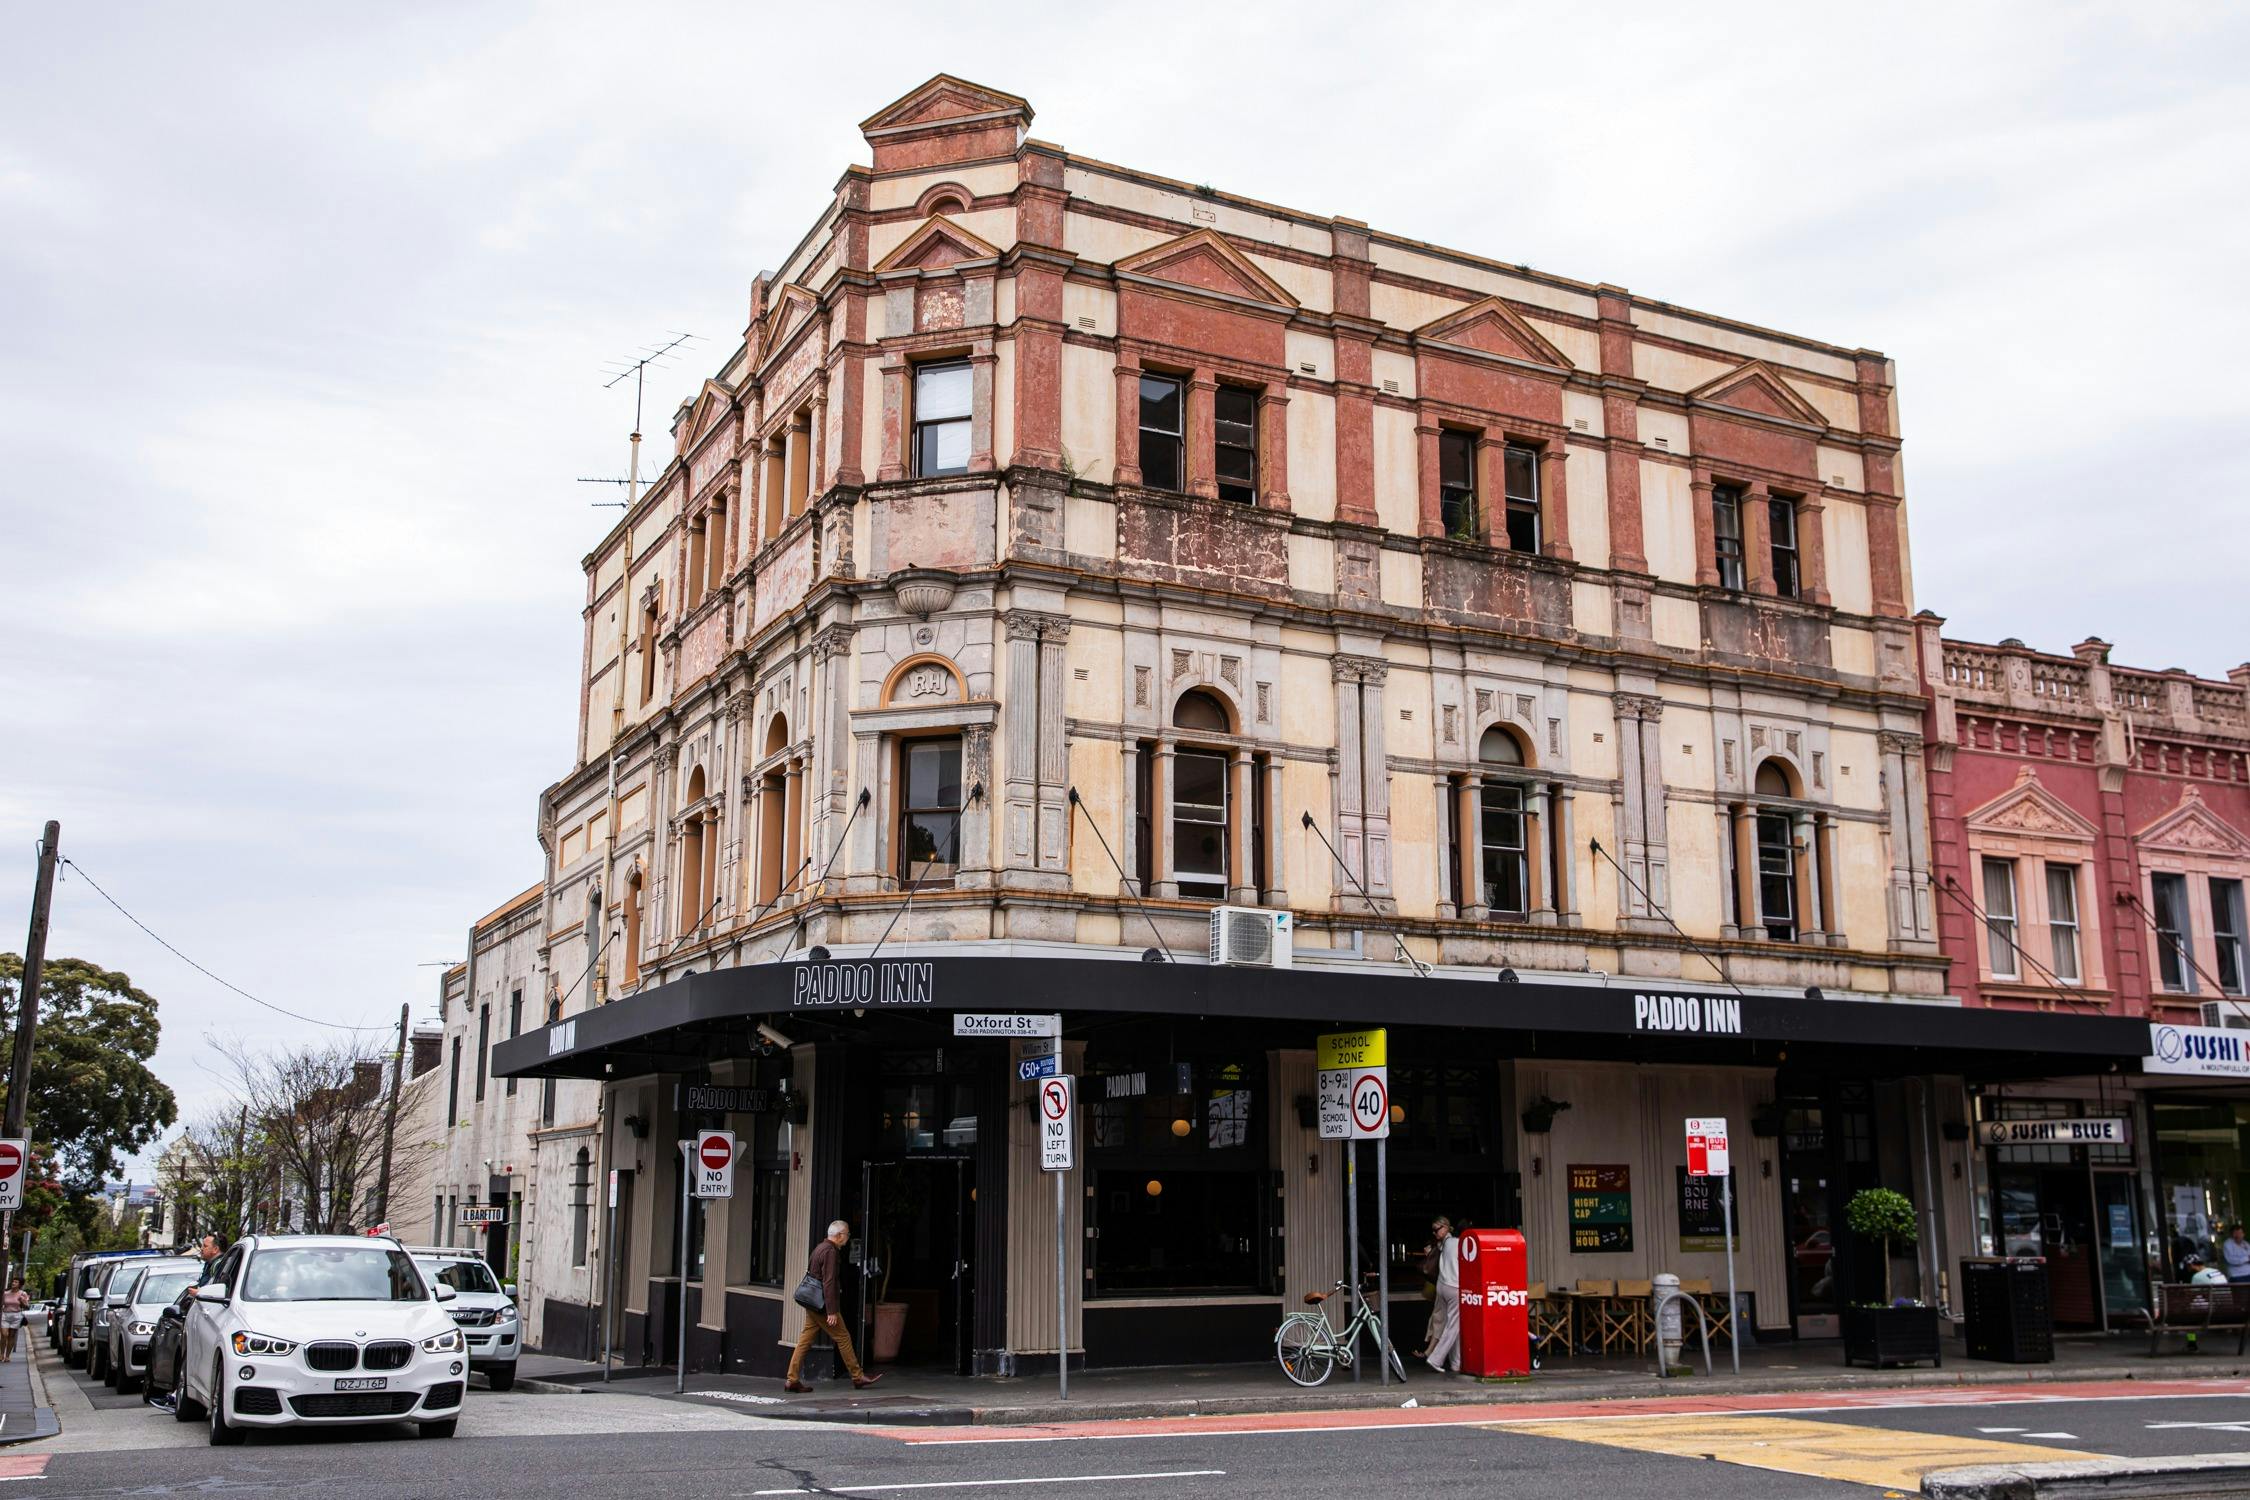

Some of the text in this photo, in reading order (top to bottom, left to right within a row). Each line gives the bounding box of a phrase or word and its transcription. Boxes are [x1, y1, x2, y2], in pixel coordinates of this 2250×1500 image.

[915, 672, 941, 691] RH
[794, 963, 933, 1005] PADDO INN
[1635, 994, 1742, 1034] PADDO INN
[964, 1016, 1032, 1029] Oxford St
[1331, 1036, 1370, 1049] SCHOOL
[2184, 1033, 2240, 1061] SUSHI
[1338, 1052, 1364, 1064] ZONE
[1025, 1062, 1040, 1078] 50+
[1106, 1072, 1146, 1098] PADDO INN
[688, 1087, 737, 1110] PADDO
[1357, 1090, 1380, 1116] 40
[1322, 1113, 1348, 1122] SCHOOL
[1048, 1122, 1064, 1136] NO
[1325, 1125, 1343, 1134] DAYS
[2011, 1123, 2056, 1140] SUSHI
[2072, 1122, 2112, 1139] BLUE
[1046, 1140, 1066, 1150] LEFT
[1046, 1153, 1067, 1163] TURN
[706, 1171, 723, 1181] NO
[1574, 1176, 1597, 1188] JAZZ
[700, 1184, 728, 1193] ENTRY
[1684, 1187, 1709, 1197] BOU
[1574, 1198, 1599, 1207] NIGHT
[1685, 1199, 1709, 1210] RNE
[463, 1208, 501, 1221] IL BARETTO
[1574, 1209, 1591, 1218] CAP
[1576, 1237, 1600, 1247] HOUR
[1461, 1293, 1483, 1306] POST
[1487, 1290, 1528, 1306] POST
